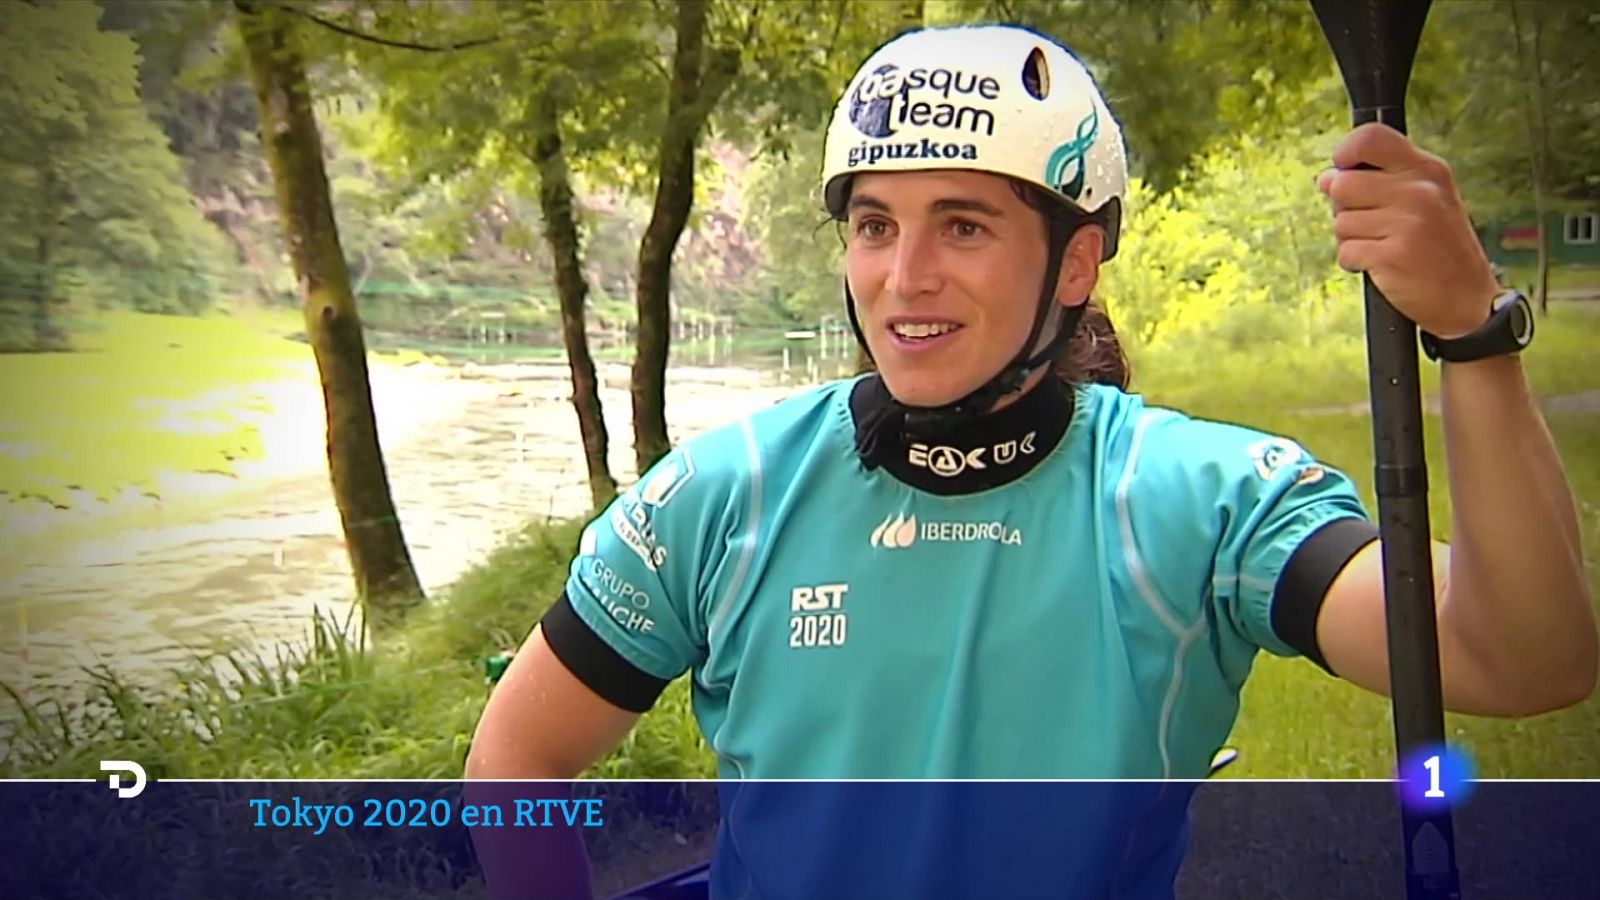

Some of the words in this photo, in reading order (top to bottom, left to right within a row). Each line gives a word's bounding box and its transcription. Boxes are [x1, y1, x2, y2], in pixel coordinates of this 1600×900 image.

[847, 138, 979, 167] gipuzkoa
[920, 522, 1022, 546] IBERDROLA
[591, 558, 650, 611] GRUPO
[791, 584, 849, 612] RST
[789, 614, 847, 648] 2020
